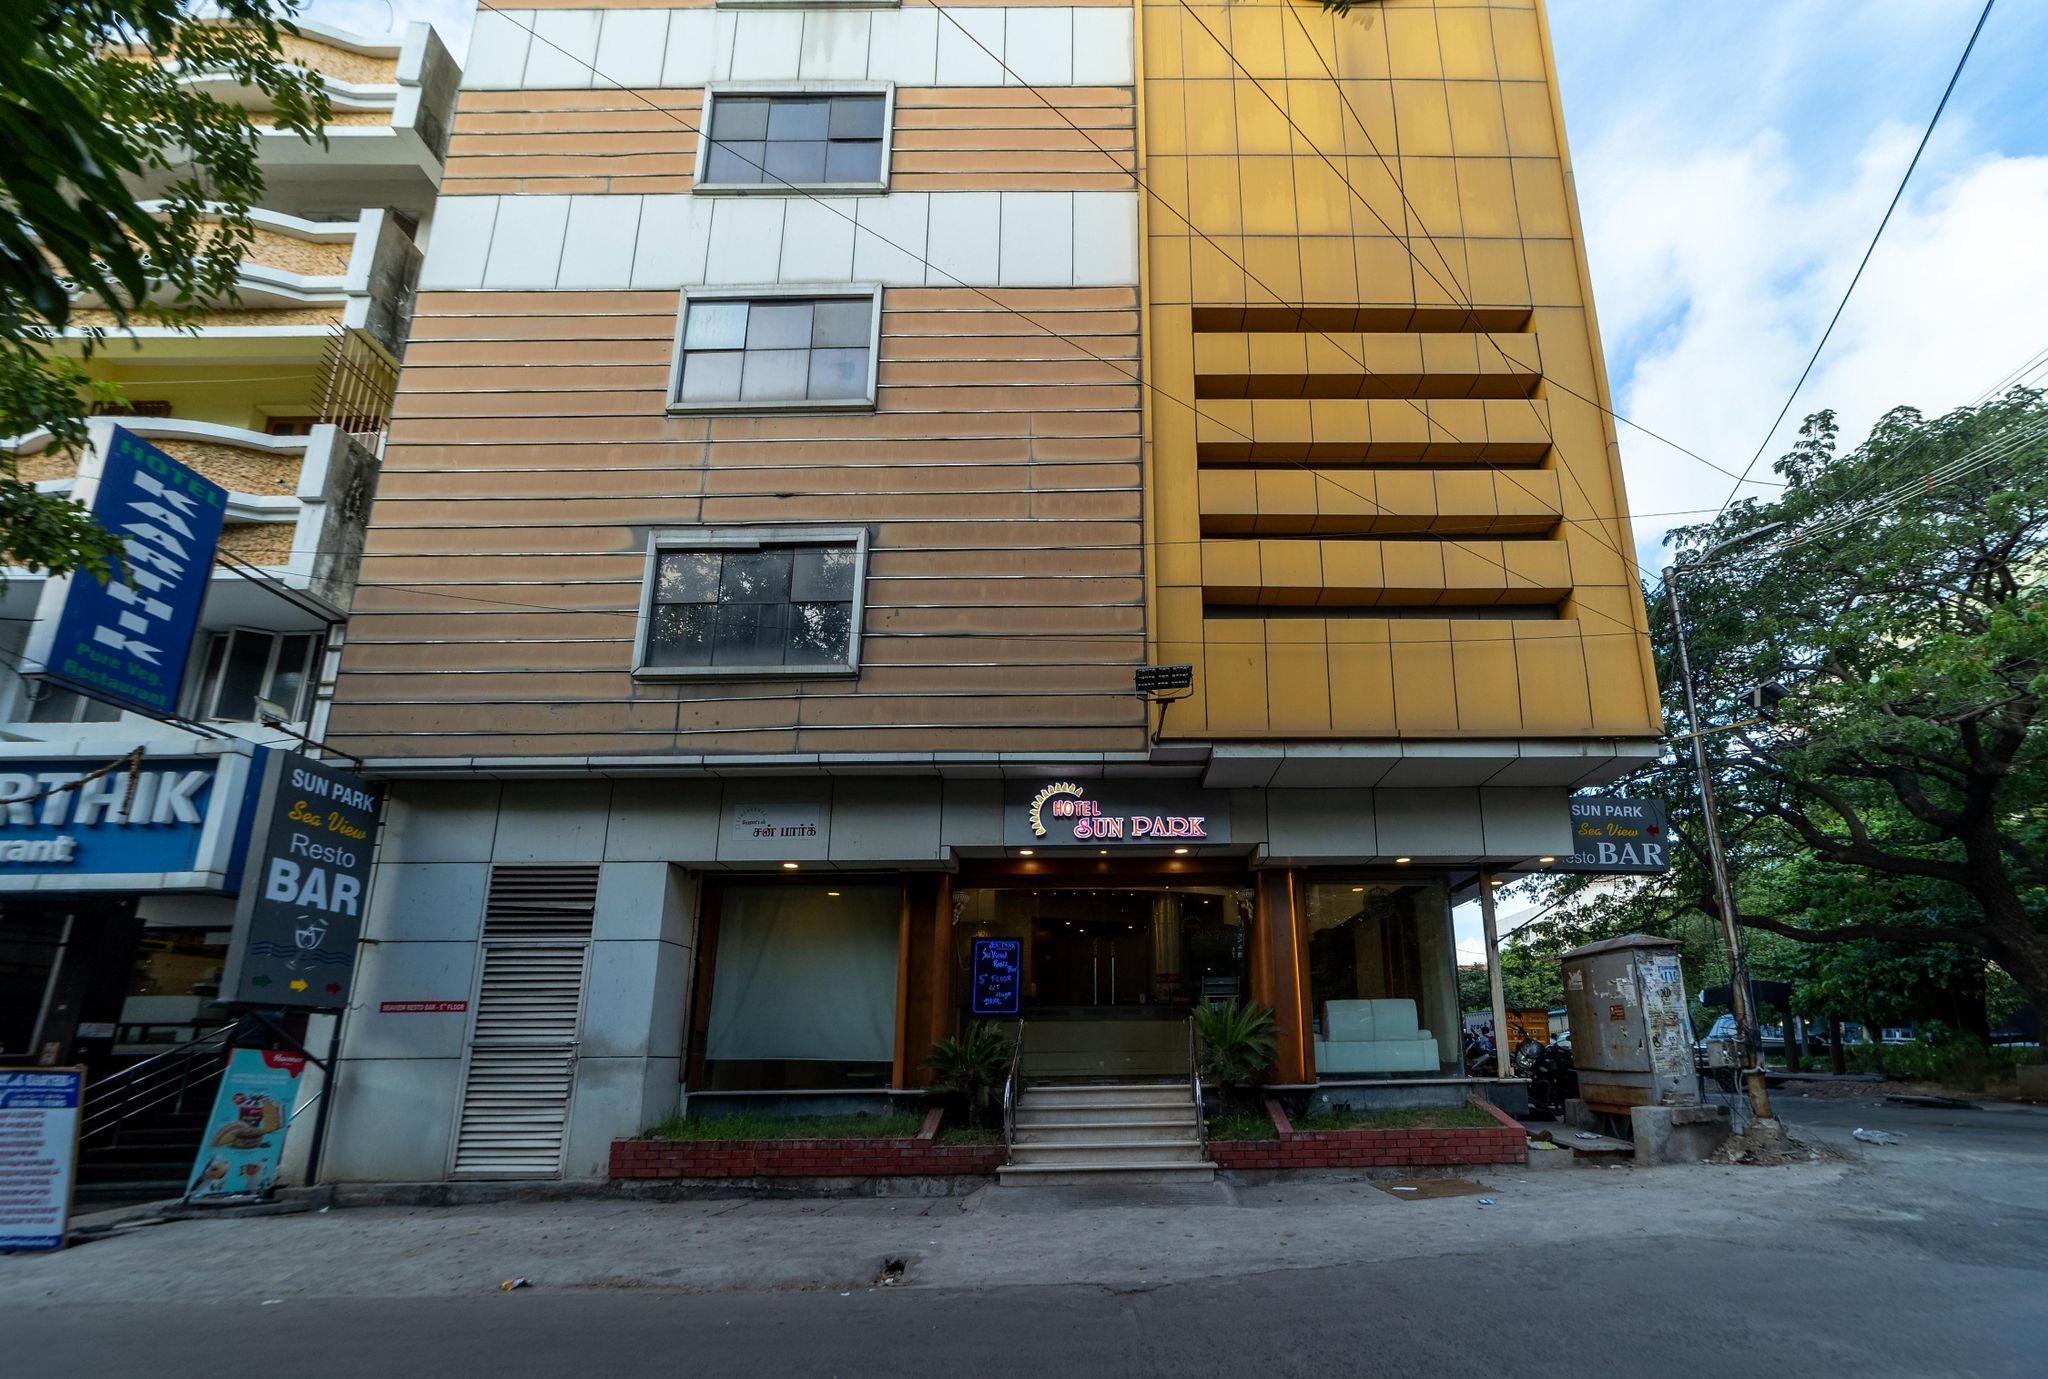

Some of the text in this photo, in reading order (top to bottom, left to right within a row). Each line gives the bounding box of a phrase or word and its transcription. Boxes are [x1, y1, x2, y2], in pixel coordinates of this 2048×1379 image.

[119, 439, 221, 509] HOTEL
[76, 643, 121, 669] Pure
[63, 658, 167, 707] Restaurant
[291, 768, 376, 813] SUN PARK
[288, 800, 368, 840] Sea View
[1052, 800, 1101, 817] HOTEL
[1571, 804, 1644, 818] SUN PARK
[753, 823, 816, 837] சன் பார்க்
[1073, 816, 1207, 839] SUN PARK
[1578, 822, 1639, 837] Sea View
[289, 833, 356, 868] Resto
[1562, 842, 1665, 866] esto BAR
[265, 857, 361, 916] BAR
